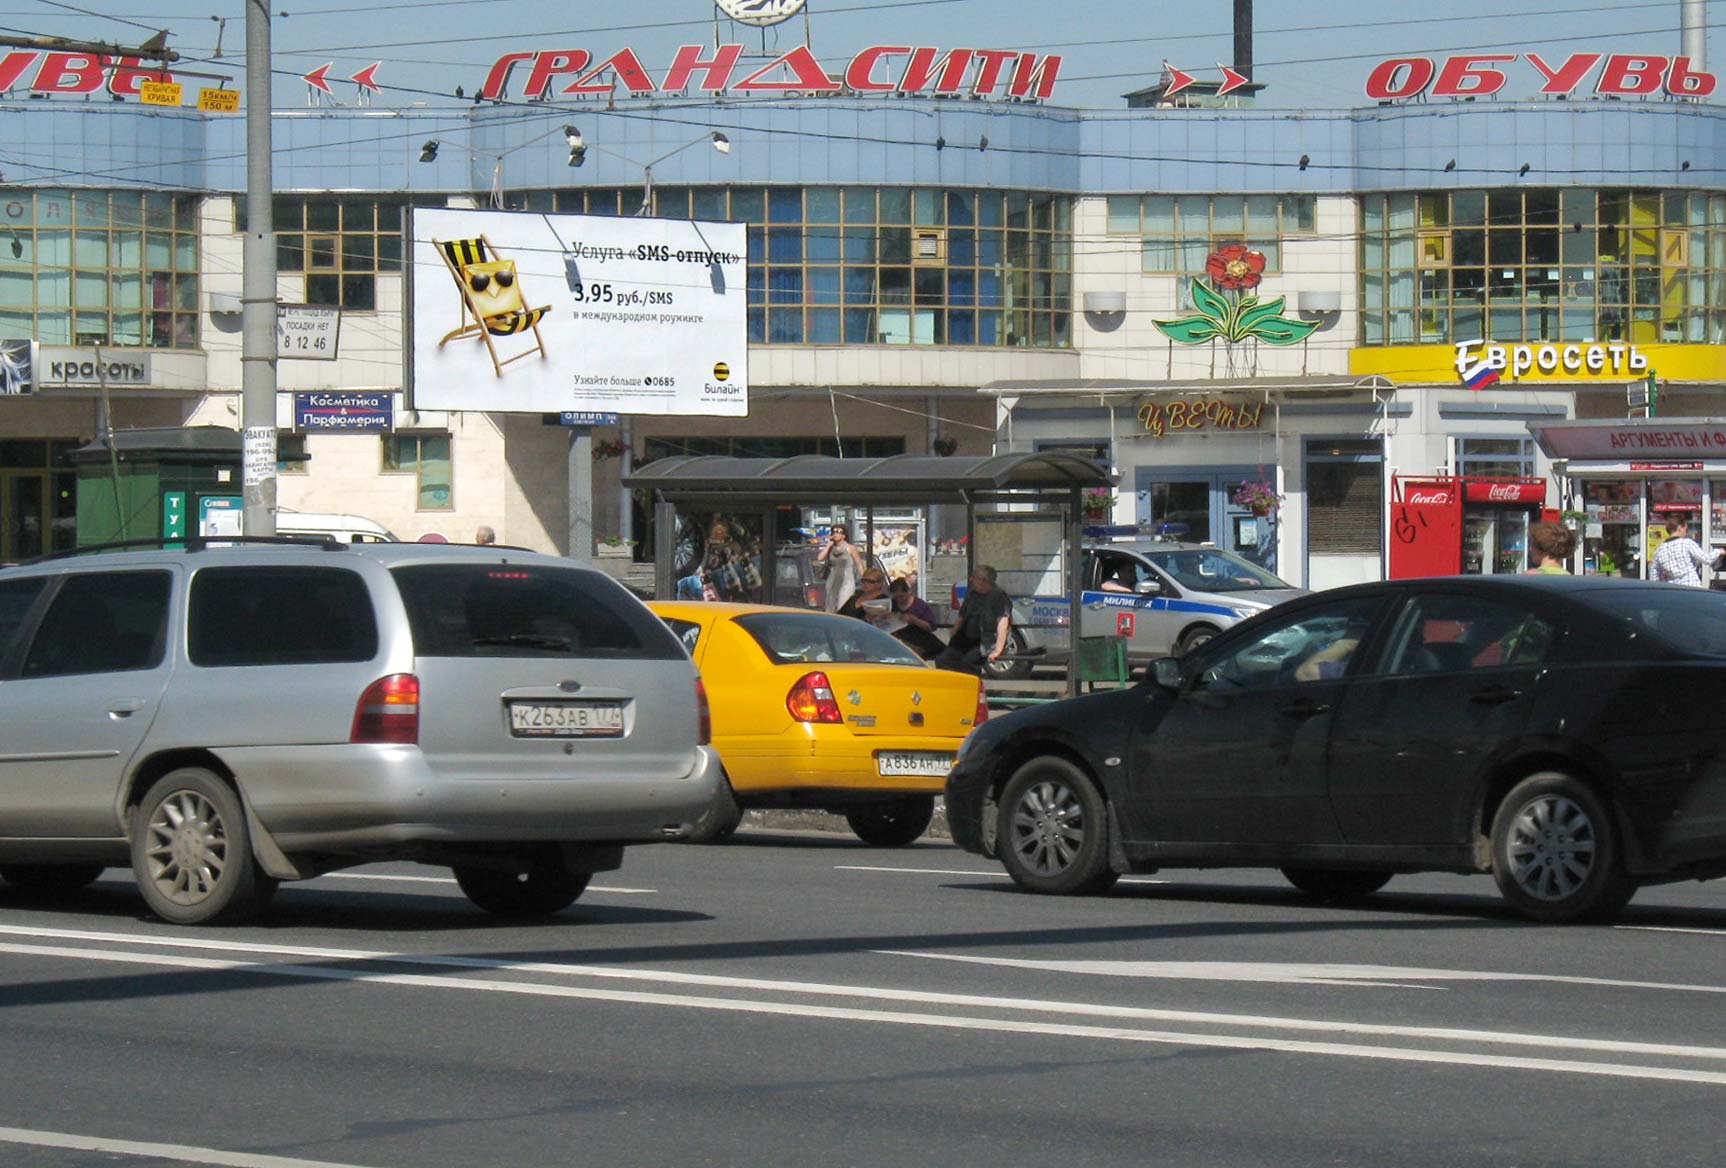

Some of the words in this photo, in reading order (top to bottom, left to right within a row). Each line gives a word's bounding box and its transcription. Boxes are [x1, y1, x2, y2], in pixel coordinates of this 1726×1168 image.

[1365, 52, 1718, 98] ОБУВЬ
[204, 102, 221, 110] 150
[572, 242, 624, 263] Услуга
[628, 245, 740, 267] «SMS-отпуск»
[574, 284, 613, 304] 3,95
[617, 290, 673, 306] руб./SMS
[581, 312, 658, 323] международном
[659, 314, 703, 325] роуминге
[284, 336, 291, 348] 8
[297, 336, 309, 349] 12
[314, 337, 326, 350] 46
[1455, 339, 1648, 377] Евросеть
[51, 361, 145, 385] красоты
[574, 375, 609, 387] Узнайте
[610, 375, 642, 387] больше
[653, 377, 675, 387] 0685
[309, 395, 379, 406] Косметика
[303, 413, 385, 426] Парфюмерия
[565, 412, 603, 420] ОЛИМП
[1610, 432, 1698, 449] АРГУМЕНТЫ
[1699, 431, 1713, 447] И
[1032, 606, 1070, 617] МОСКВ
